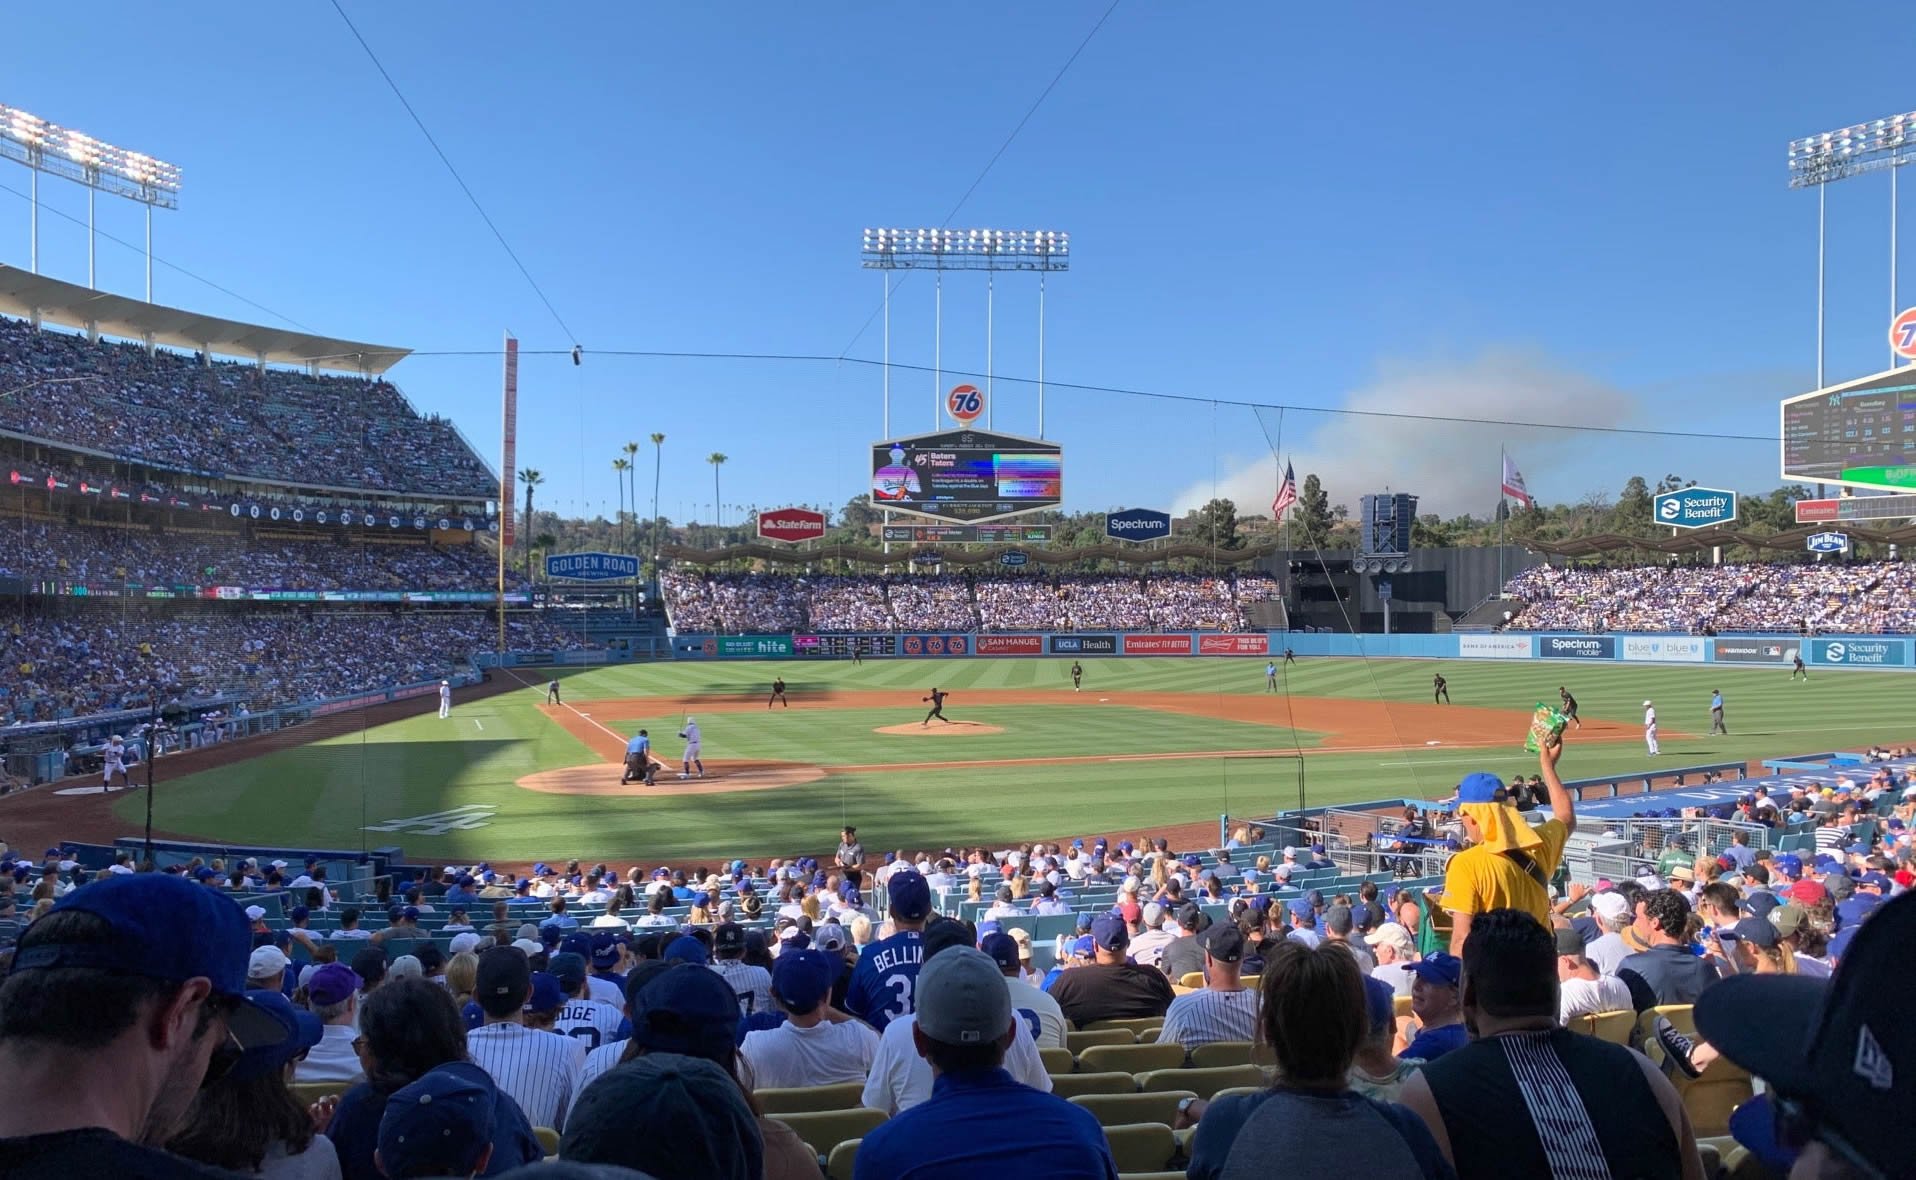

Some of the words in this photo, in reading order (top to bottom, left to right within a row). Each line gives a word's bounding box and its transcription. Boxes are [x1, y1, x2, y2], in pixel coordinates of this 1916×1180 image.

[951, 390, 981, 413] 76
[1684, 496, 1727, 508] Security
[1685, 507, 1721, 518] Benefit
[1111, 519, 1163, 531] Spectrum
[1811, 536, 1824, 548] JIM
[1824, 533, 1845, 547] BEAM
[551, 556, 599, 574] GOLDEN
[603, 557, 635, 573] ROAD
[758, 641, 787, 653] hite
[1082, 640, 1111, 649] Health
[1126, 640, 1161, 649] Emirates
[1171, 640, 1190, 648] BETTER
[1552, 639, 1601, 651] Spectrum
[1628, 643, 1650, 652] blue
[1666, 643, 1689, 652] blue
[1848, 643, 1888, 654] Security
[1849, 653, 1882, 662] Benefit
